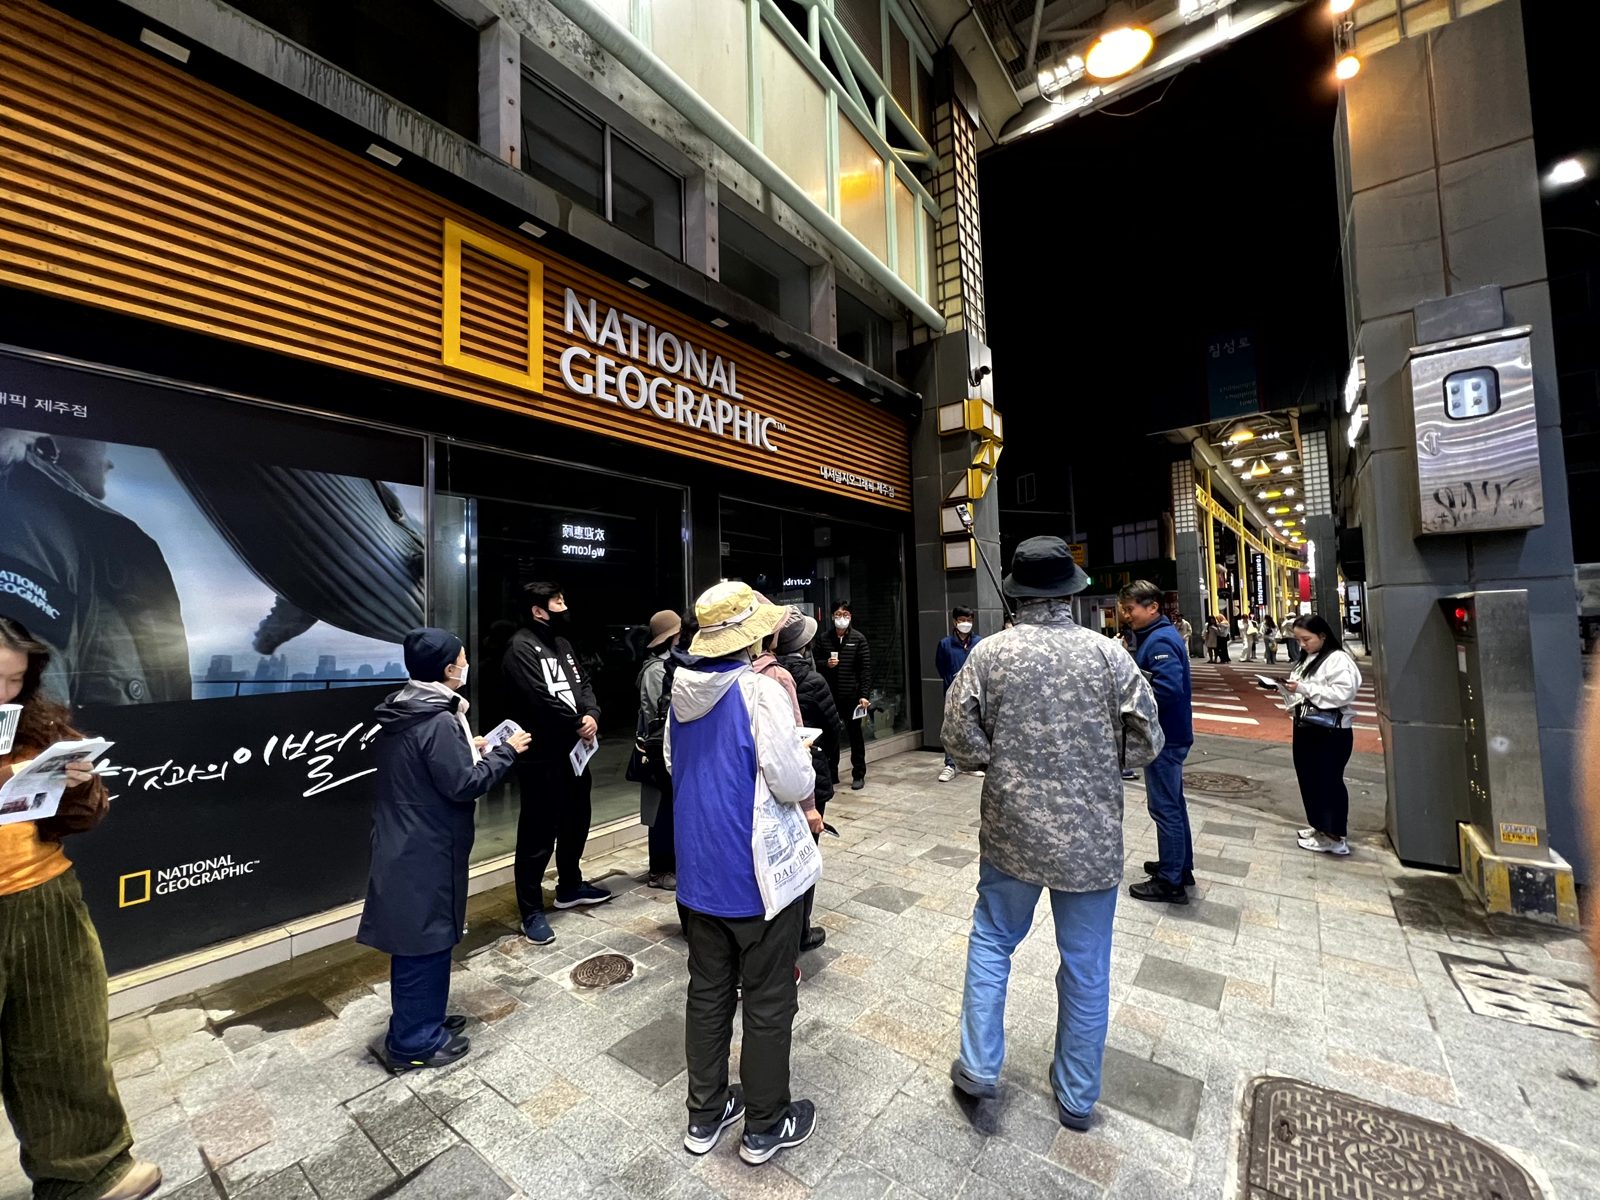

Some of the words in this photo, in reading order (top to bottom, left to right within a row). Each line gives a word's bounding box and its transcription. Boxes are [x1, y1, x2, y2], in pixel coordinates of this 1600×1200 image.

[564, 287, 744, 400] NATIONAL
[34, 398, 87, 418] 제주점
[560, 346, 778, 451] GEOGRAPHIC
[877, 481, 895, 498] 제주점
[155, 861, 254, 895] GEOGRAPHIC
[157, 854, 235, 882] NATIONAL
